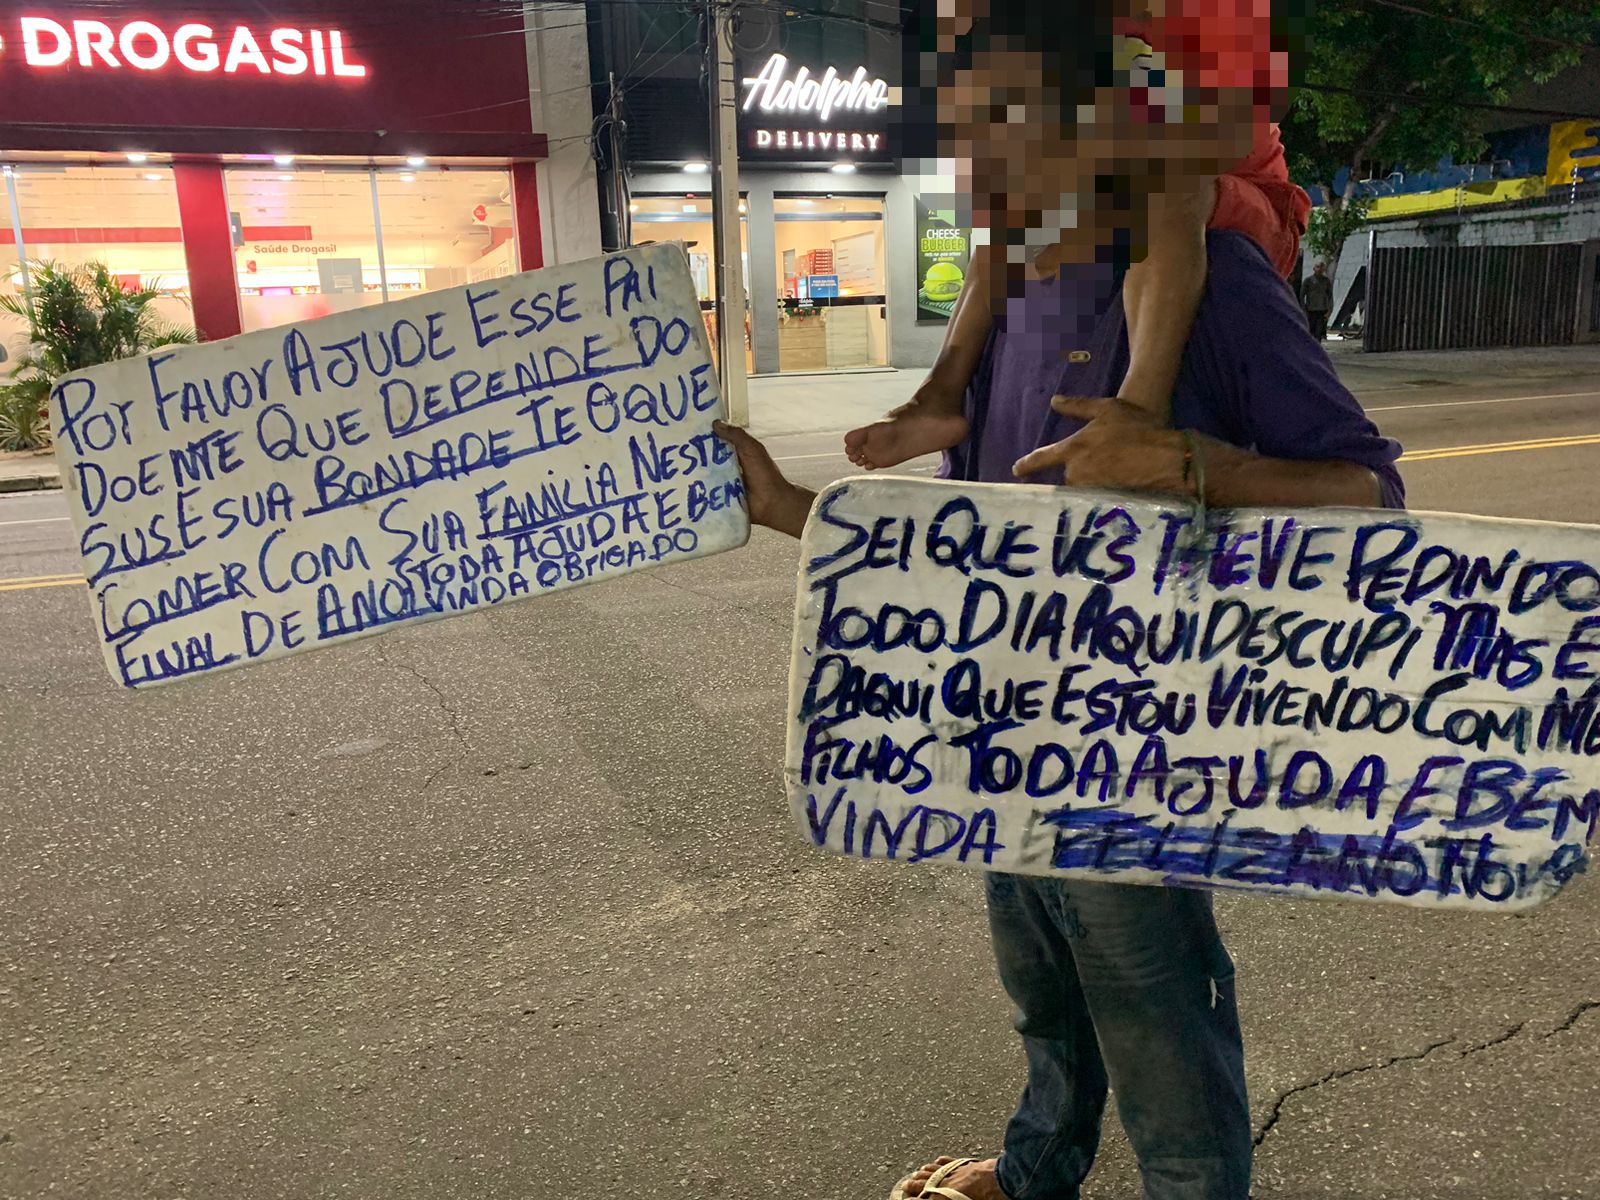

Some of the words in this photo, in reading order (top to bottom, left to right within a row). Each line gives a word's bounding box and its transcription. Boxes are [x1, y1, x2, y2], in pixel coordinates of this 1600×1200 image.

[20, 16, 367, 77] DROGASIL
[742, 53, 889, 120] Adolpho
[756, 129, 880, 149] DELIVERY
[254, 244, 288, 254] Saúde
[292, 244, 337, 255] Drogasil
[922, 238, 965, 252] BURGER
[926, 228, 961, 240] CHEESE
[283, 312, 456, 395] AJUDE
[466, 283, 582, 347] ESSE
[604, 256, 656, 317] PAI
[256, 404, 370, 461] QUE
[380, 334, 611, 435] DEPENDE
[630, 316, 690, 367] DO
[97, 562, 257, 642] COMER
[259, 528, 370, 593] COM
[379, 498, 468, 565] SUA
[629, 431, 733, 490] NESTE
[241, 610, 305, 657] DE
[504, 499, 651, 569] AJUDA
[688, 478, 746, 522] BEM
[806, 485, 915, 574] SEI
[926, 496, 1039, 578] QUE
[1344, 521, 1600, 615] PEDINDO
[810, 577, 946, 654] TODO
[941, 658, 1047, 722] QUE
[1052, 664, 1196, 736] ESTOU
[1412, 672, 1532, 755] COM
[806, 787, 1005, 864] VINDA
